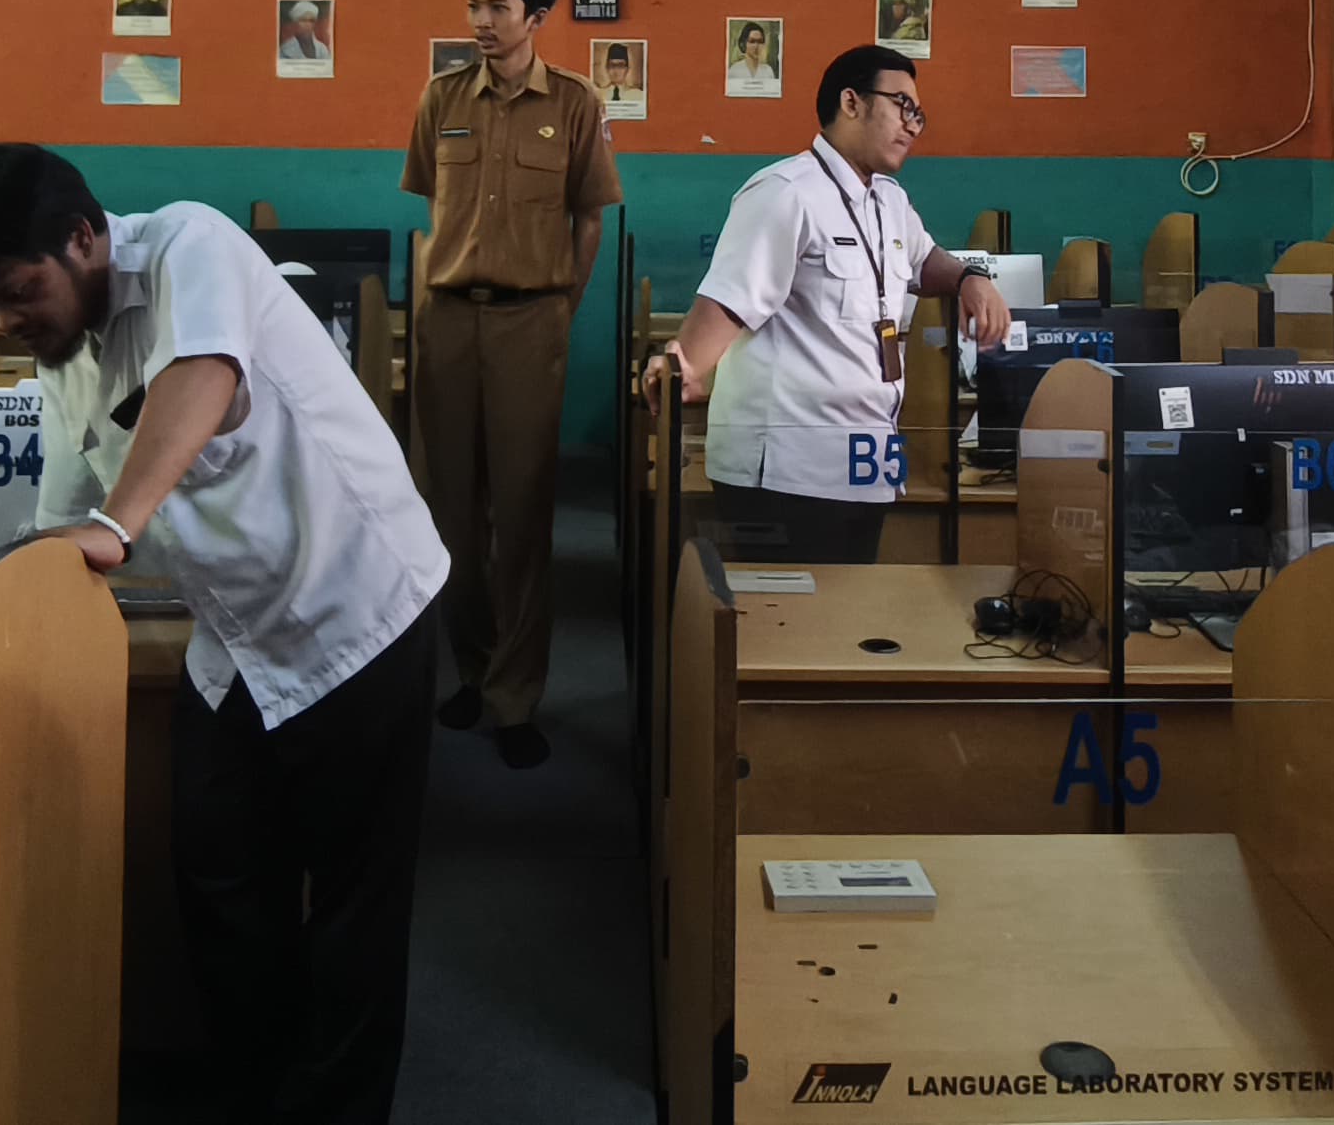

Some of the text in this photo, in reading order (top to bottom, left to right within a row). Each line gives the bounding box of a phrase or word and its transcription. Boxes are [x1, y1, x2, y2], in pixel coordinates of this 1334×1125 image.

[1035, 331, 1064, 345] SDN
[1273, 369, 1311, 385] SDN
[4, 414, 40, 427] BOS
[848, 434, 908, 486] B5
[1053, 712, 1162, 806] A5
[908, 1070, 1334, 1097] LANGUAGE LABORATORY SYSTEM
